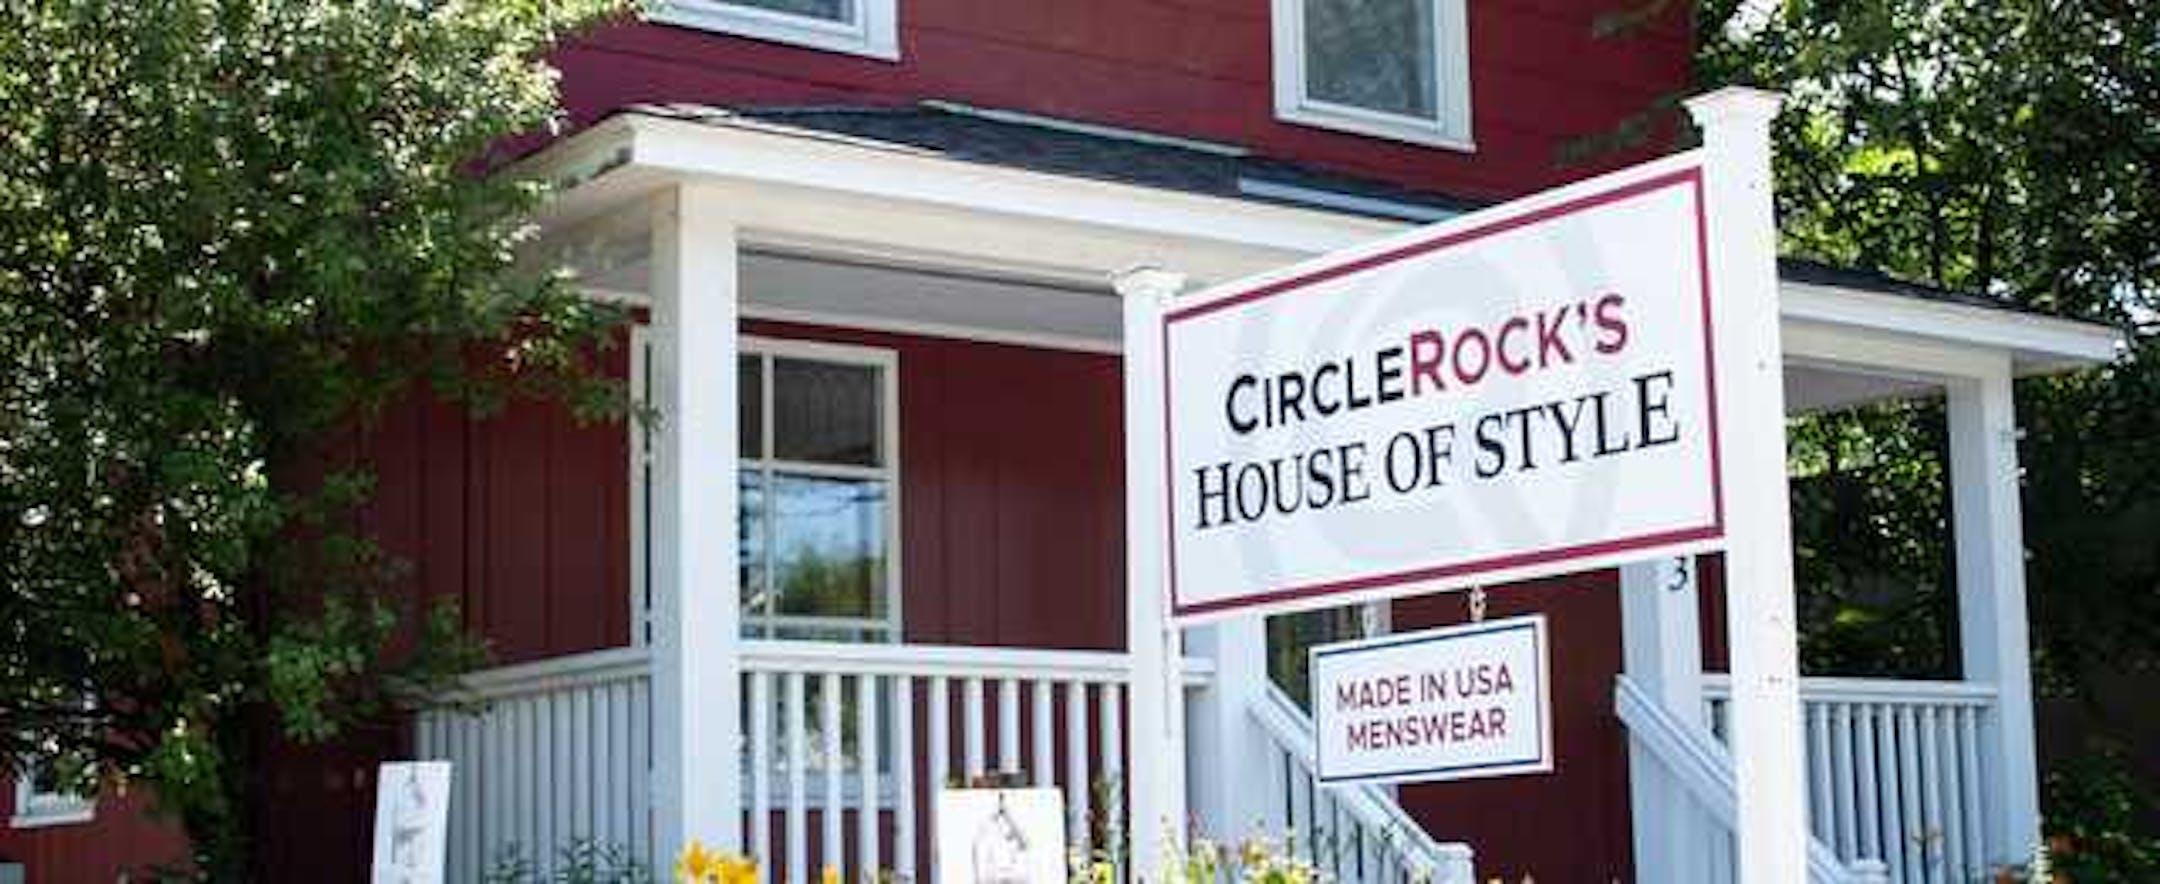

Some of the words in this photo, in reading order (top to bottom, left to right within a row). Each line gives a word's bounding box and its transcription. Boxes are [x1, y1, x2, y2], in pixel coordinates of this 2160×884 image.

[1225, 294, 1629, 435] CIRCLEROCK'S
[1193, 442, 1371, 531] HOUSE
[1384, 424, 1456, 495] OF
[1474, 370, 1681, 481] STYLE
[1667, 555, 1688, 591] 3
[1336, 674, 1412, 712] MADE
[1420, 671, 1449, 702] IN
[1455, 662, 1515, 699] USA
[1346, 706, 1507, 752] MENSWEAR
